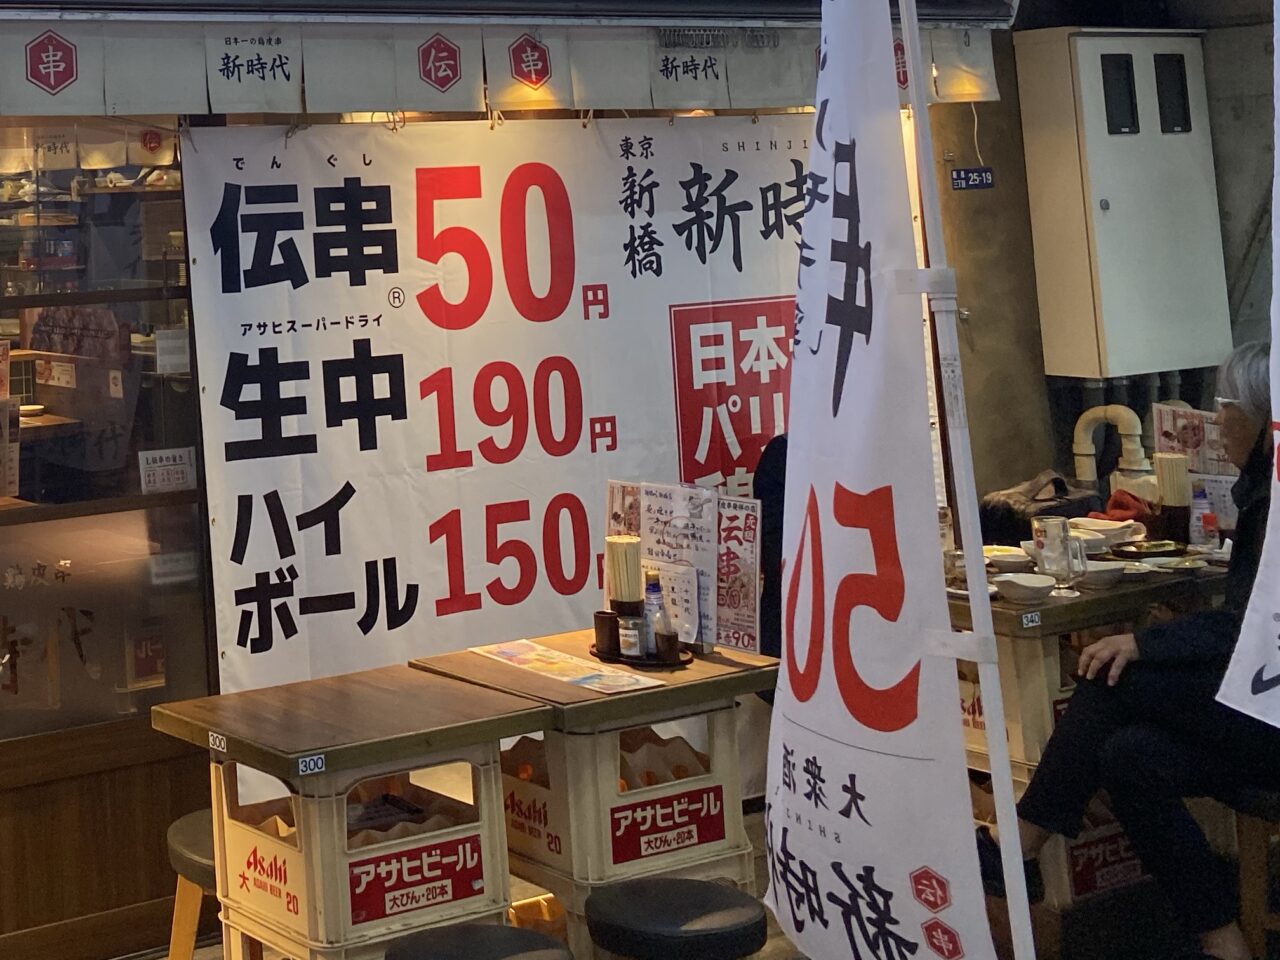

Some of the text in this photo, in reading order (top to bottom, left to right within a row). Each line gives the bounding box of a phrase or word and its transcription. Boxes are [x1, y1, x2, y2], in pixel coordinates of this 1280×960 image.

[38, 45, 67, 86] 串
[217, 52, 291, 83] 新時代
[426, 50, 455, 80] 伝
[520, 47, 544, 82] 串
[659, 55, 719, 82] 新時代
[618, 136, 655, 159] 東京
[968, 172, 992, 185] 25-19
[209, 176, 400, 295] 伝串
[618, 165, 665, 280] 新橋
[239, 313, 384, 337] アサヒスーパードライ
[689, 315, 794, 390] 日本
[218, 337, 409, 464] 生中
[234, 555, 419, 655] ボール
[427, 491, 605, 617] 150
[1022, 613, 1041, 627] 340
[209, 733, 226, 750] 300
[300, 756, 325, 773] 300
[504, 790, 549, 830] Asahi
[614, 790, 721, 837] アサヒビール
[546, 831, 562, 855] 20
[246, 845, 288, 887] Asahi
[351, 842, 480, 895] アサヒビール
[238, 871, 251, 893] 大
[388, 882, 449, 911] 大びん・20本
[285, 891, 299, 916] 20
